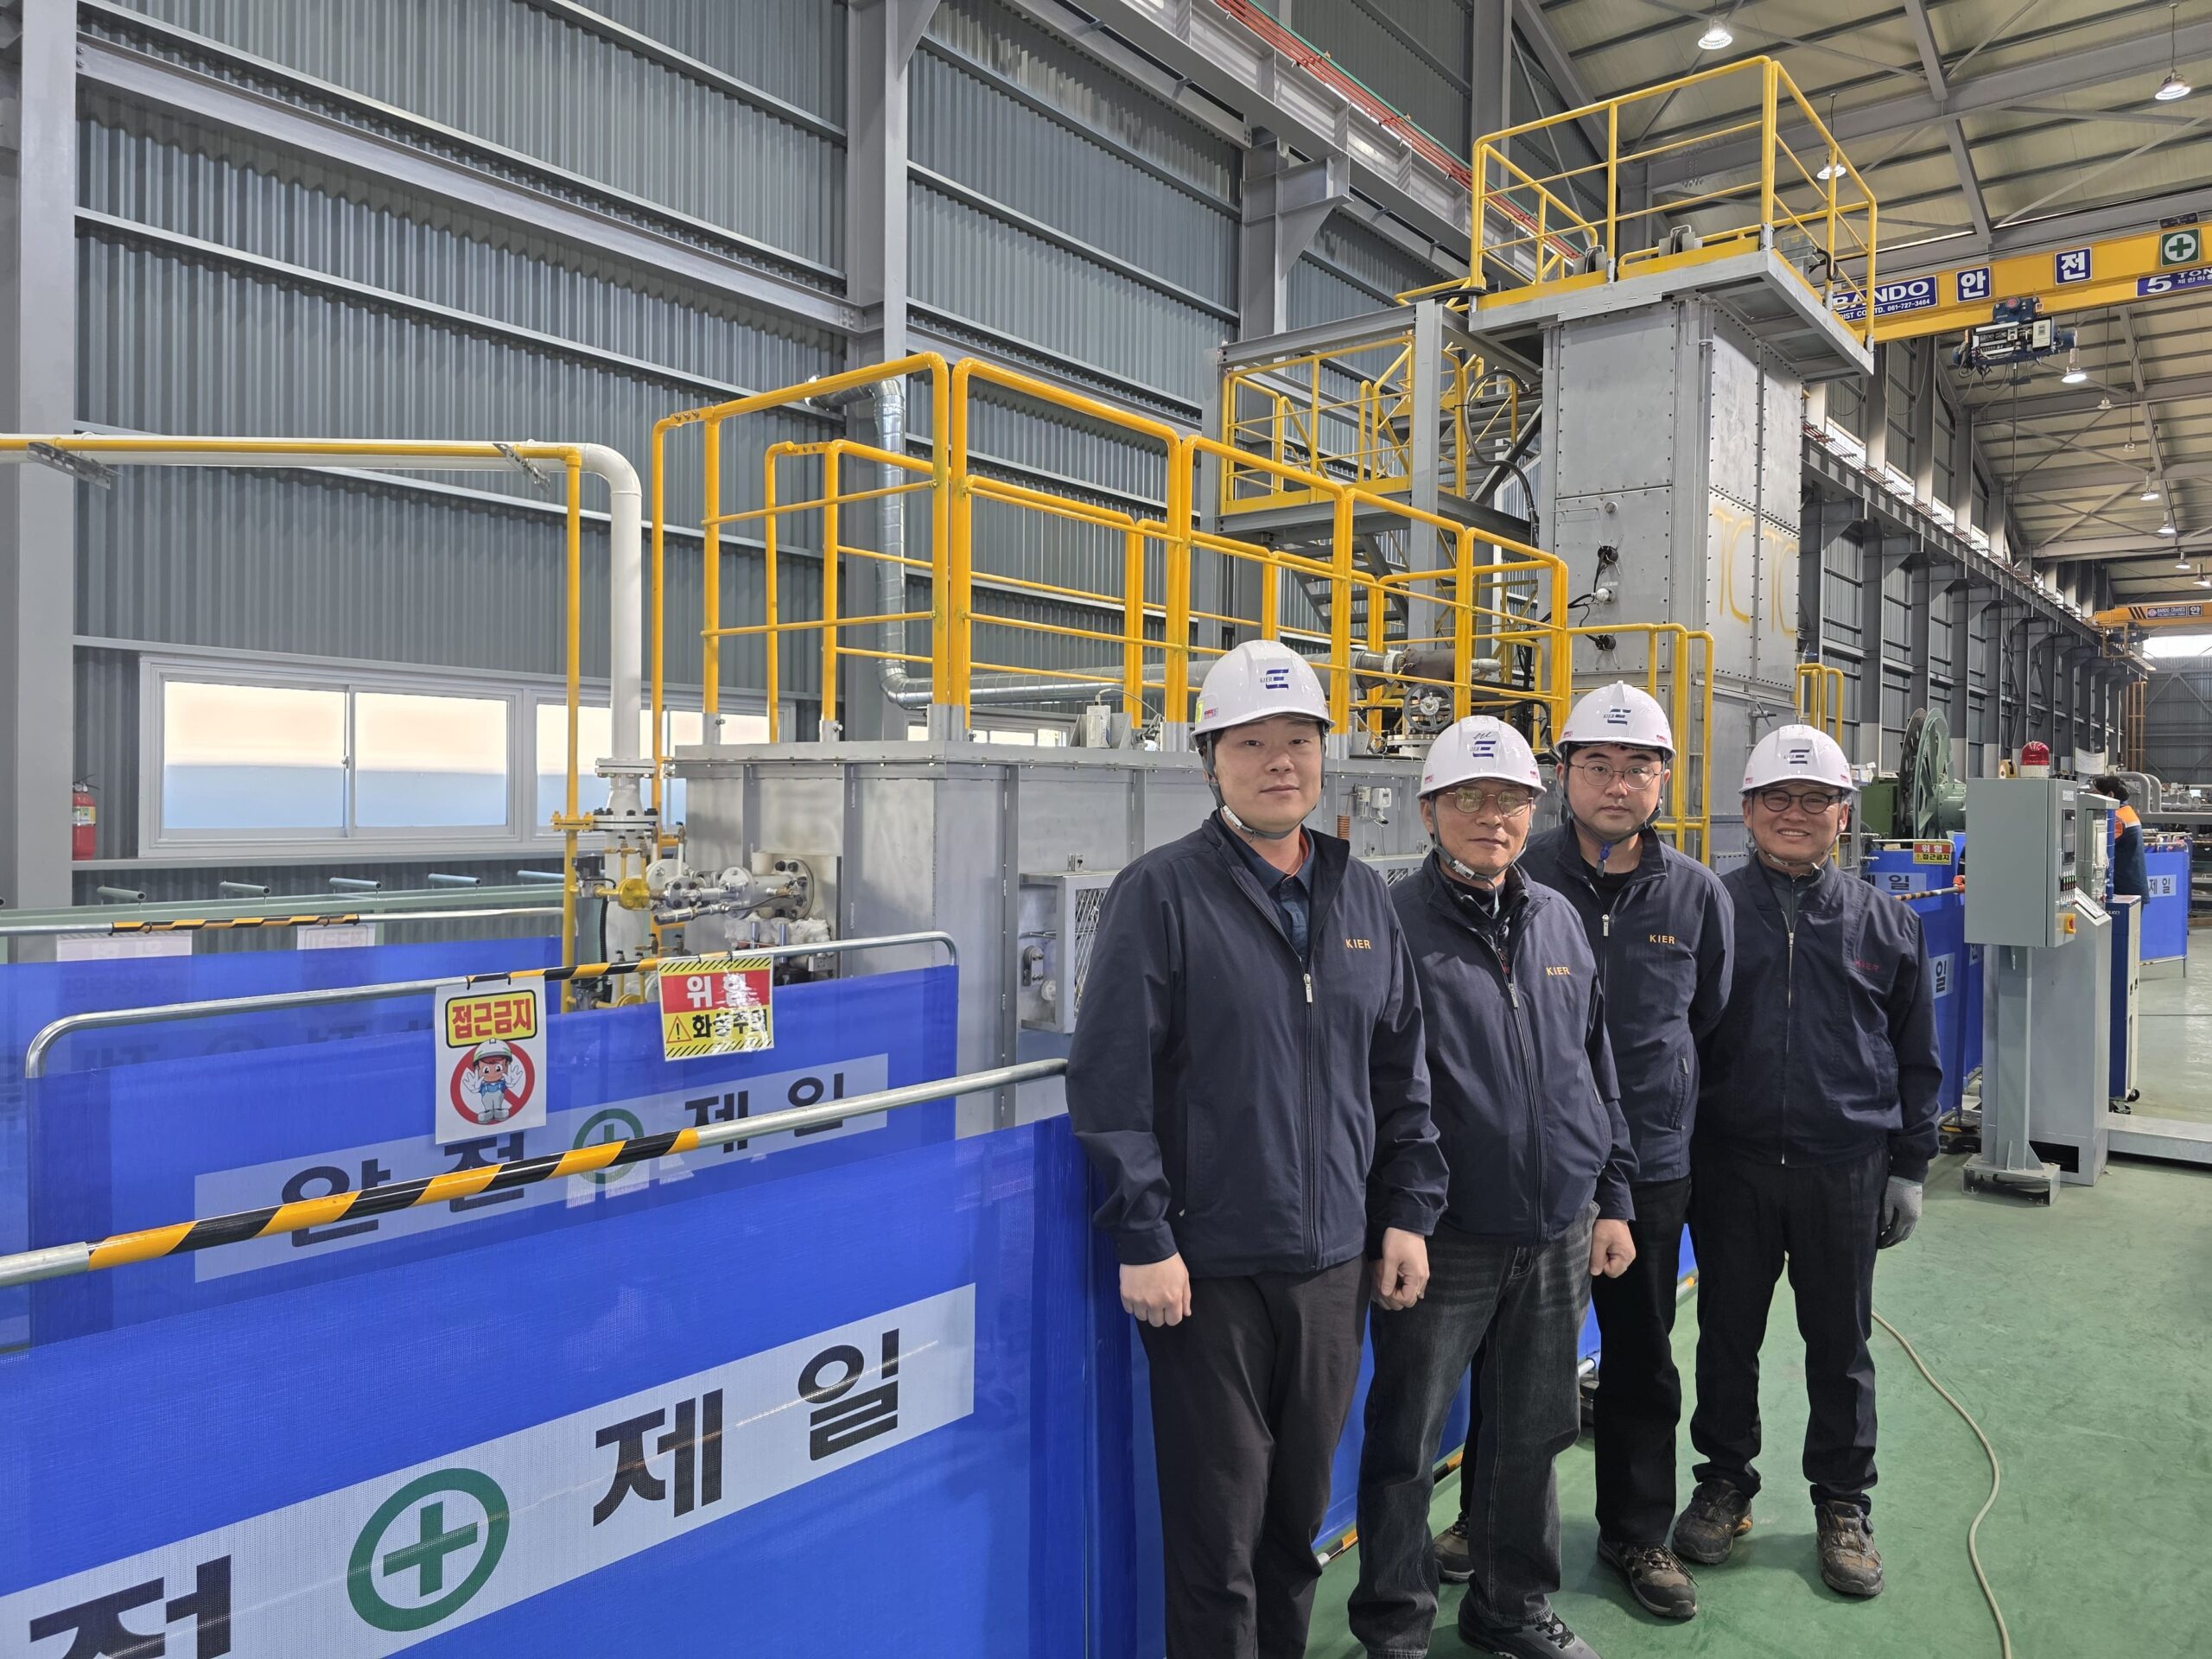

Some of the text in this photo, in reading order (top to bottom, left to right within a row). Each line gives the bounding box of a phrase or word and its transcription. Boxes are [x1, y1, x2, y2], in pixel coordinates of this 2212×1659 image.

[2146, 275, 2172, 293] 5
[1345, 938, 1371, 950] KIER
[1650, 934, 1675, 944] KIER
[1546, 966, 1571, 976] KIER
[452, 998, 531, 1039] 접근금지
